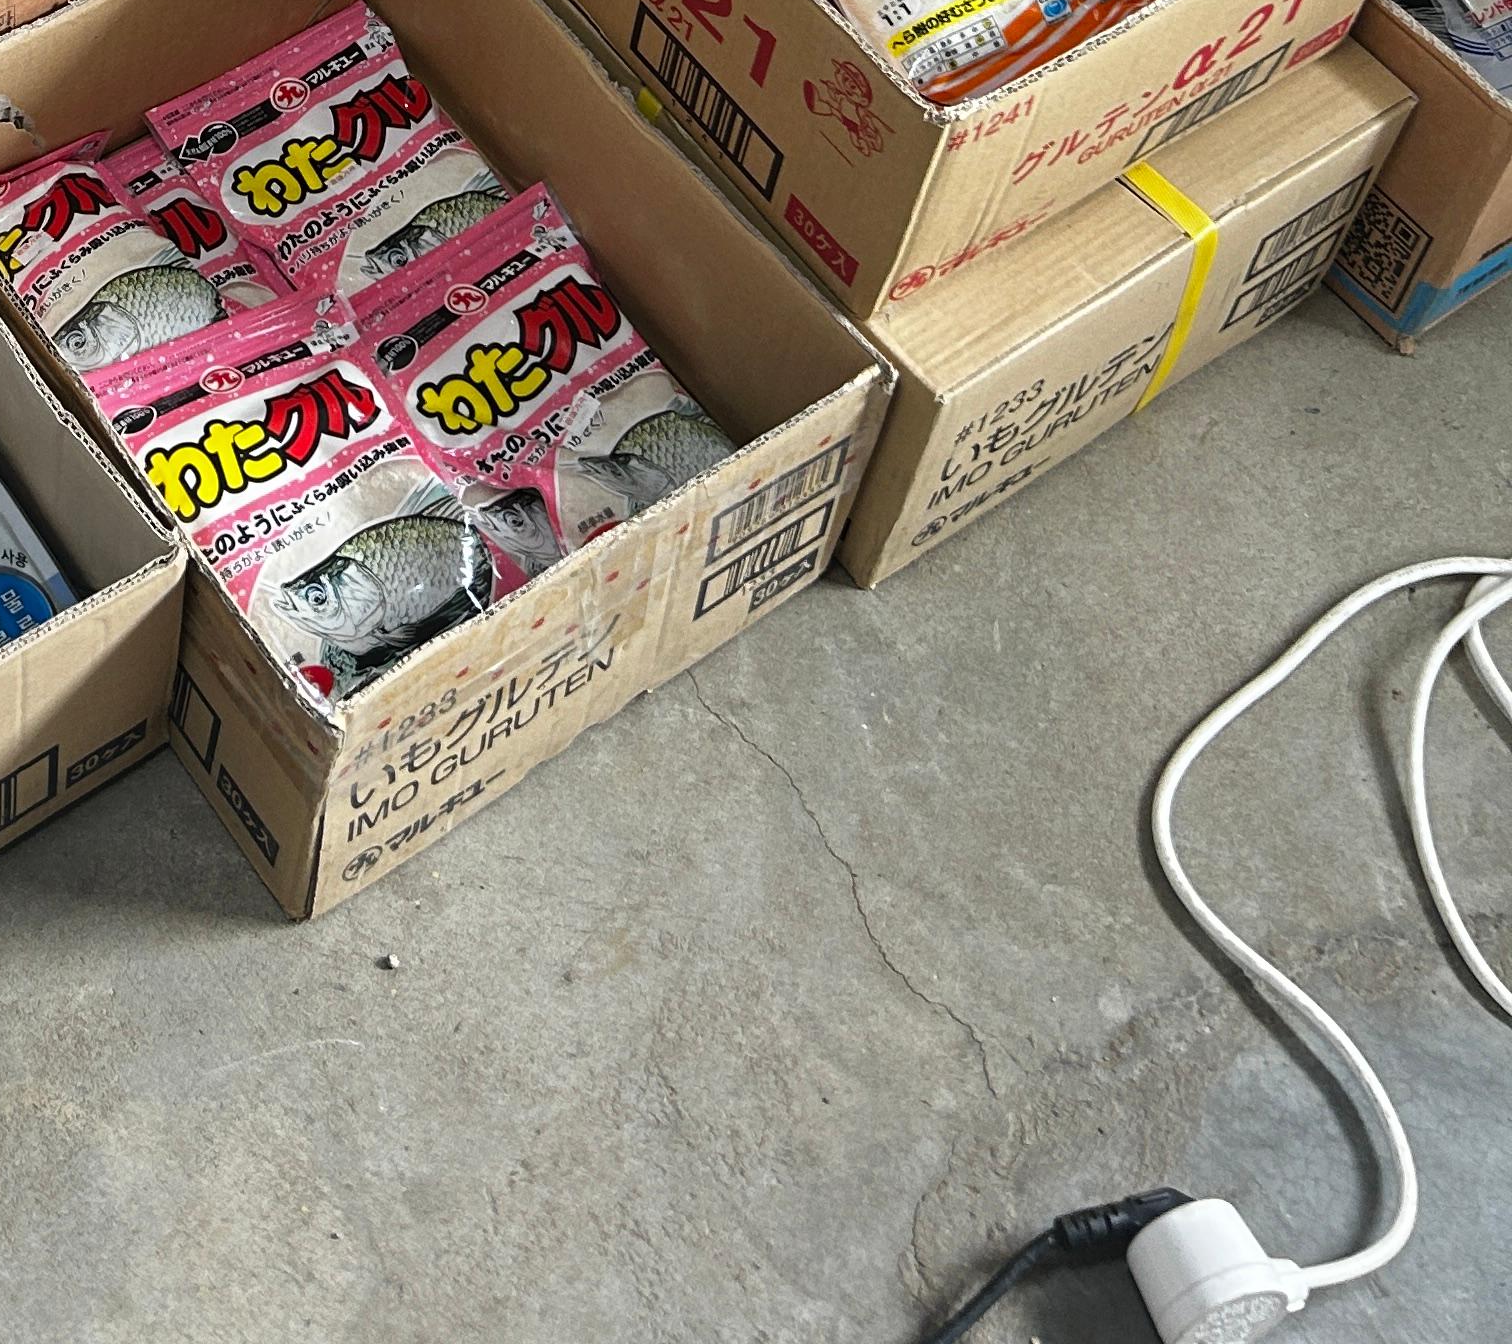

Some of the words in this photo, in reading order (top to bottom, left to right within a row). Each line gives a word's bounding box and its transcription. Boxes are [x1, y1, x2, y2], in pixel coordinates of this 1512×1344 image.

[304, 49, 363, 86] マルキュー
[234, 75, 435, 216] わたグル
[945, 93, 1038, 154] #1241
[1010, 80, 1176, 187] グルテン
[1076, 94, 1179, 166] GURUTEN
[479, 255, 538, 293] マルキュー
[240, 340, 305, 374] マルキュー
[415, 273, 622, 436] わたグル
[943, 320, 1178, 482] いもグルテン
[147, 366, 381, 523] わたグル
[926, 458, 997, 512] IMO
[998, 357, 1161, 479] GURUTEN
[951, 377, 1046, 448] #1233
[347, 772, 420, 842] IMO
[430, 644, 619, 789] GURUTEN
[348, 612, 625, 810] いもグルテン
[353, 686, 459, 762] #1233
